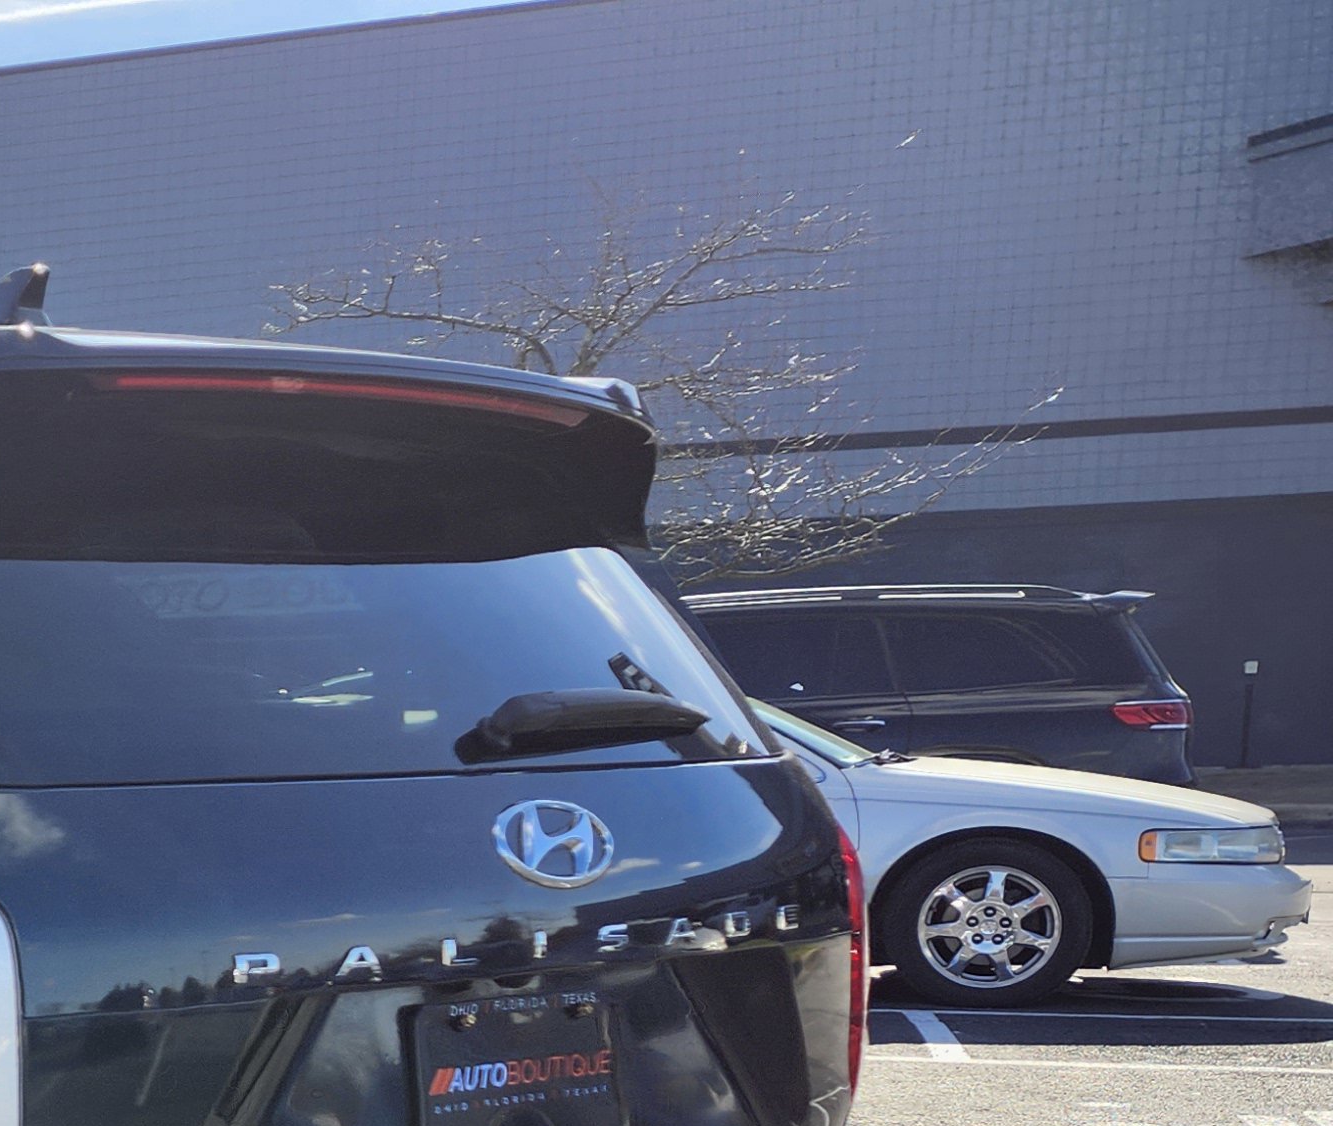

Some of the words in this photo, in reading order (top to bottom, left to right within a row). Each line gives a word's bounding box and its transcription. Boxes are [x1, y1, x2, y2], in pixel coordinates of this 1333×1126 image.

[233, 904, 800, 984] PALISADE
[494, 997, 549, 1012] FLORIDA
[562, 992, 597, 1005] TEXAS
